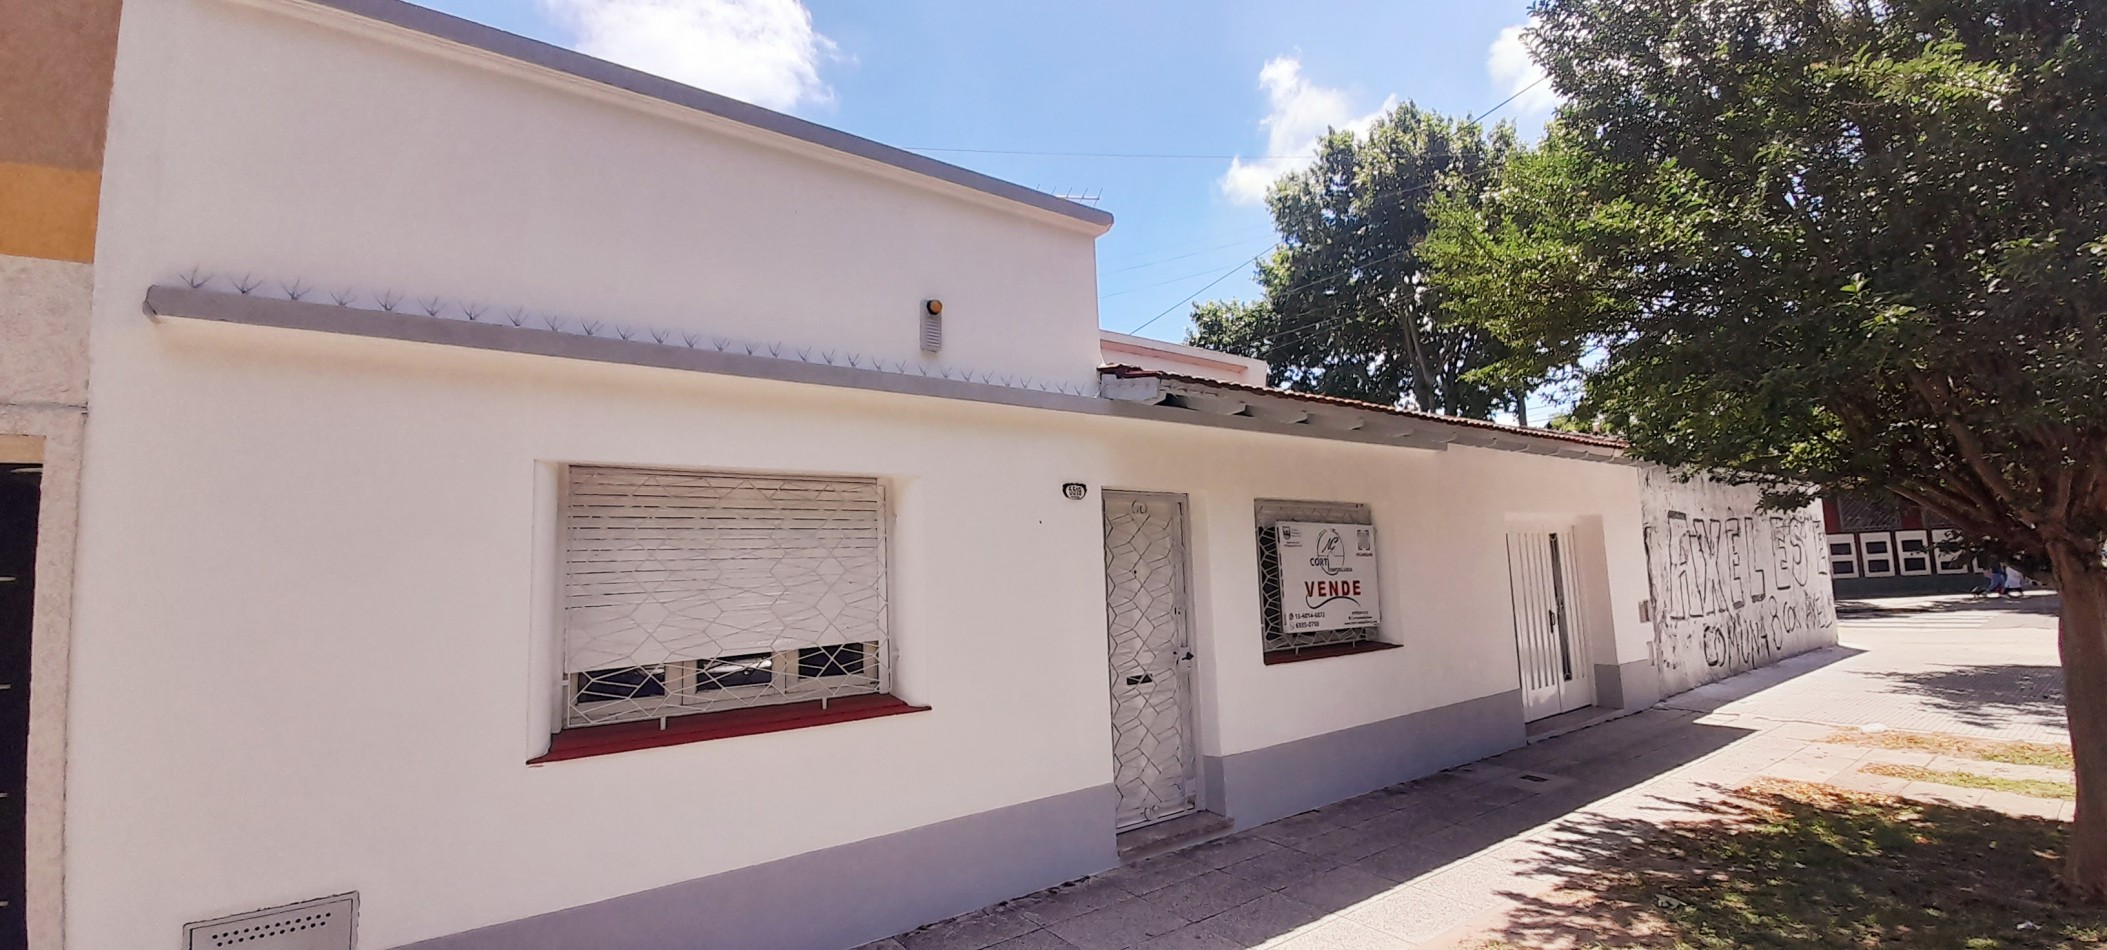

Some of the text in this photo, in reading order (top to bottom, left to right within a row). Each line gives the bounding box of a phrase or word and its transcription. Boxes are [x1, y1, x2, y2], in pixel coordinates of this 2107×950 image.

[1068, 486, 1082, 496] 5519
[1668, 510, 1766, 620] AXEL
[1304, 580, 1362, 597] VENDE
[1703, 613, 1771, 670] COMUNA
[1769, 595, 1783, 650] 8
